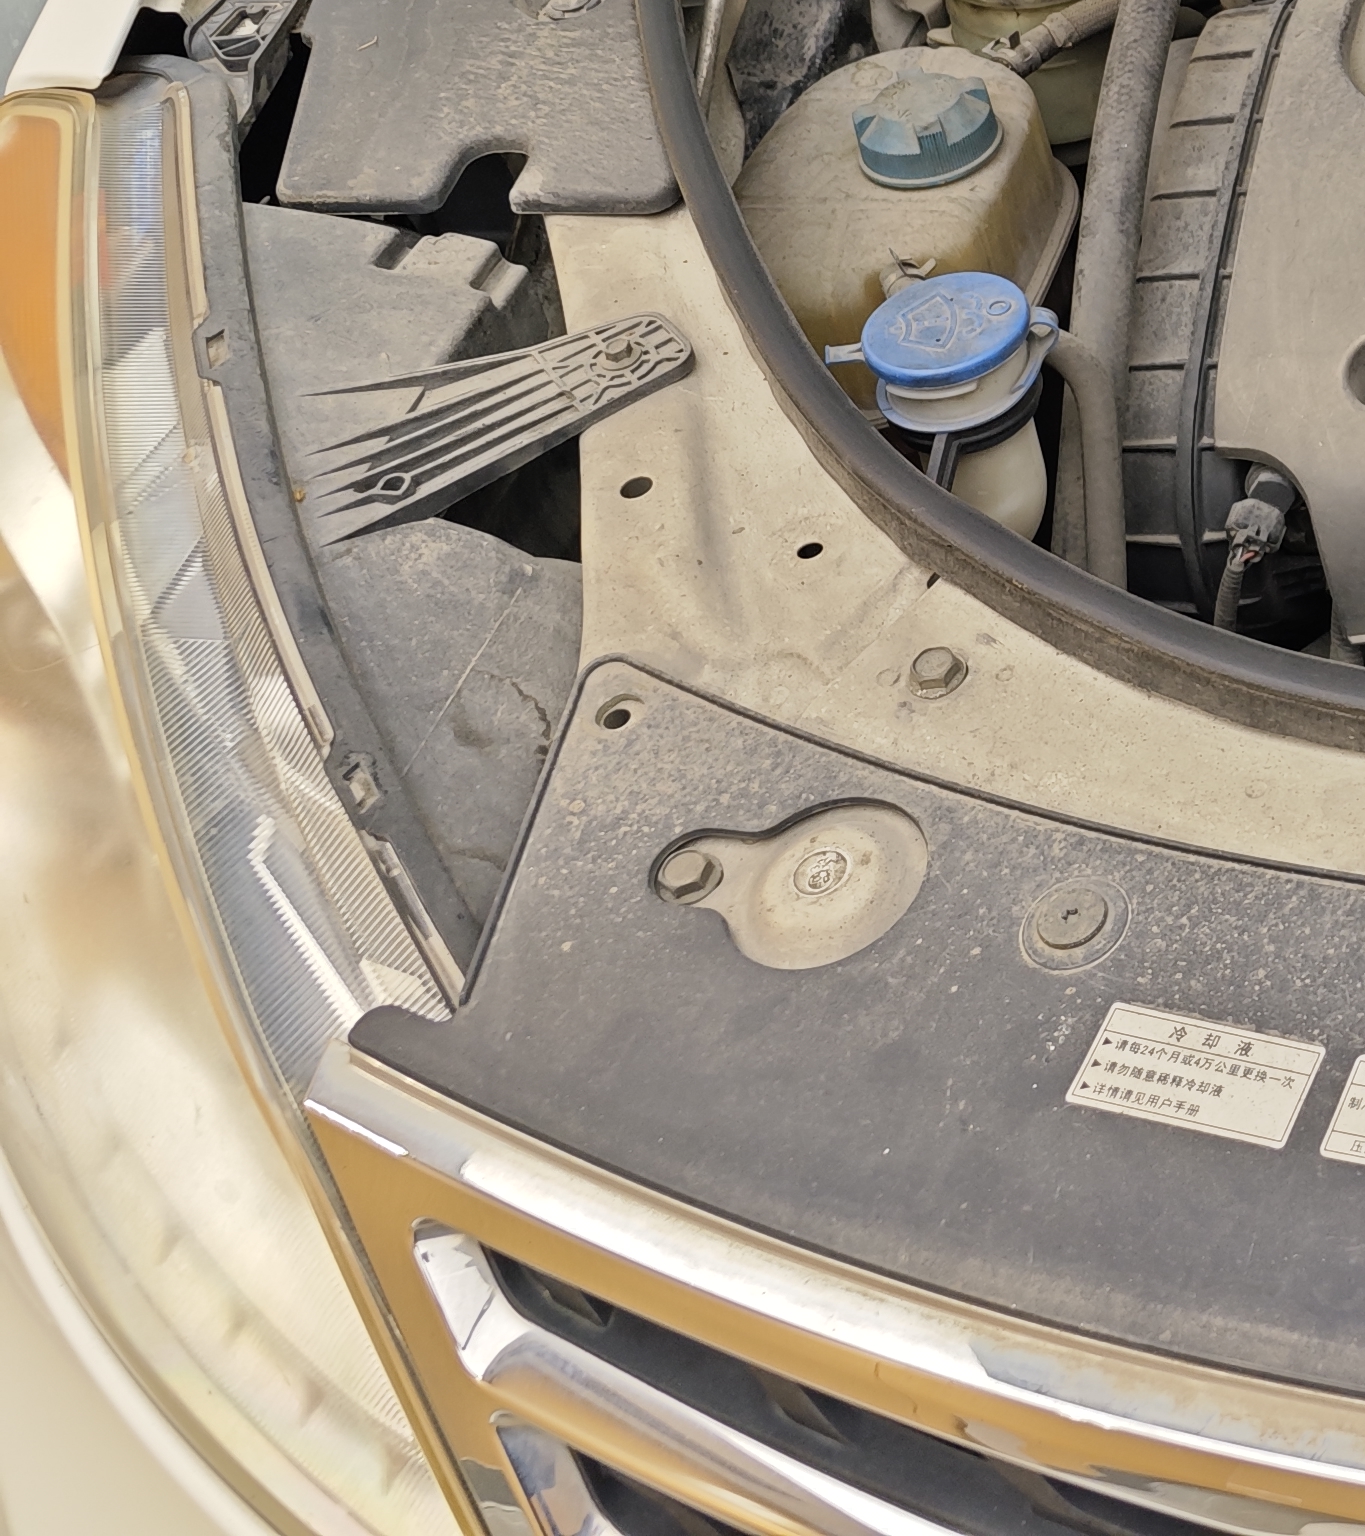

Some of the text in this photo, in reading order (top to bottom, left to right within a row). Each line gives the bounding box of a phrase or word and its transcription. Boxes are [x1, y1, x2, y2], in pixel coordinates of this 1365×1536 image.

[1168, 1025, 1256, 1058] 冷却液
[1103, 1059, 1226, 1099] 请勿随意稀释冷却液
[1114, 1037, 1297, 1090] 请每24个月或4万公里更换一次
[1092, 1081, 1201, 1117] 详情请见用户手册
